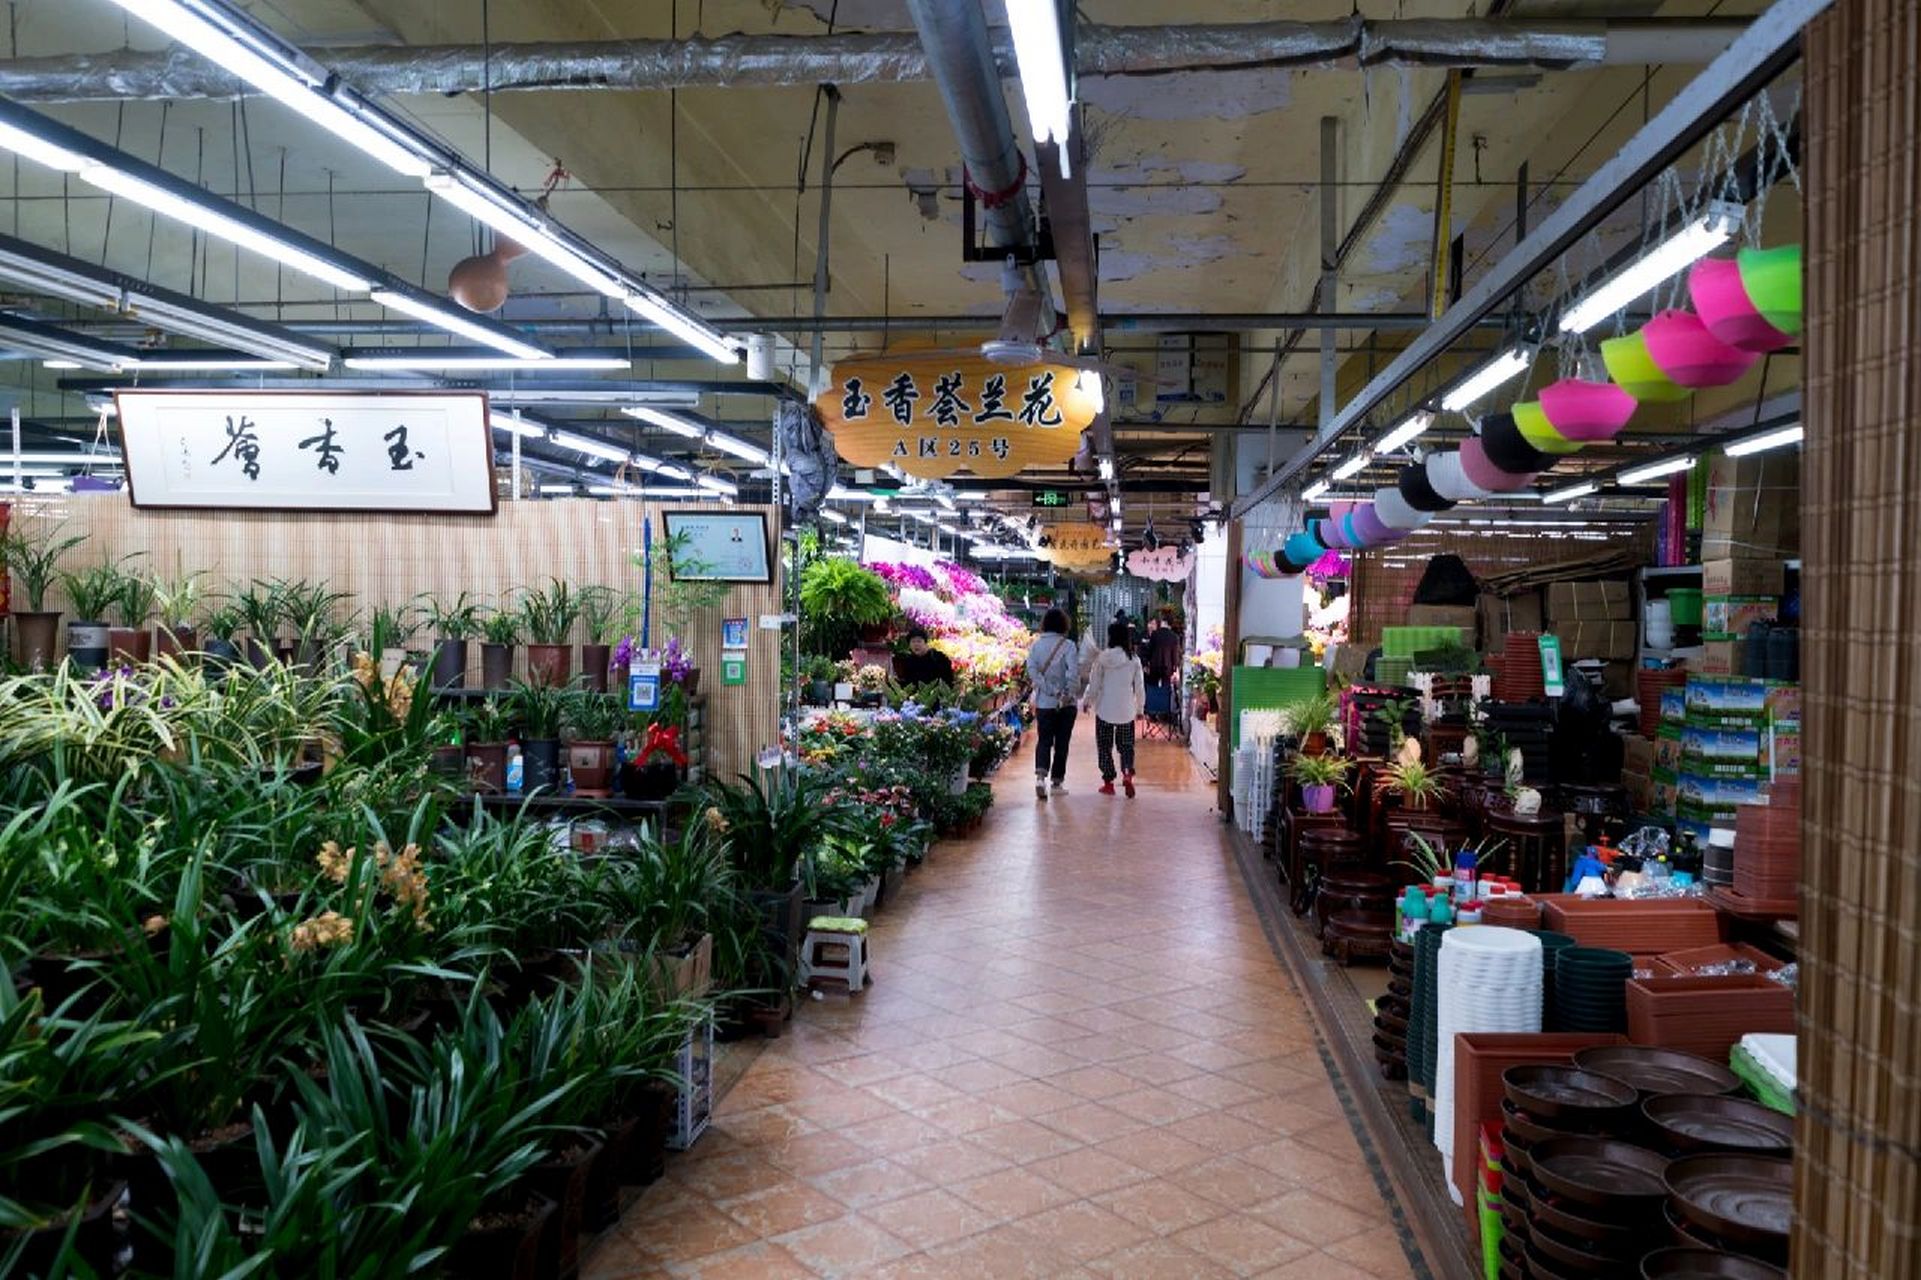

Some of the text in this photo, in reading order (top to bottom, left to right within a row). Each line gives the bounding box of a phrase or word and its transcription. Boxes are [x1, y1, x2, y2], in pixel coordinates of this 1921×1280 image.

[843, 371, 1063, 426] 玉香荟兰花
[892, 437, 1010, 459] A区25号
